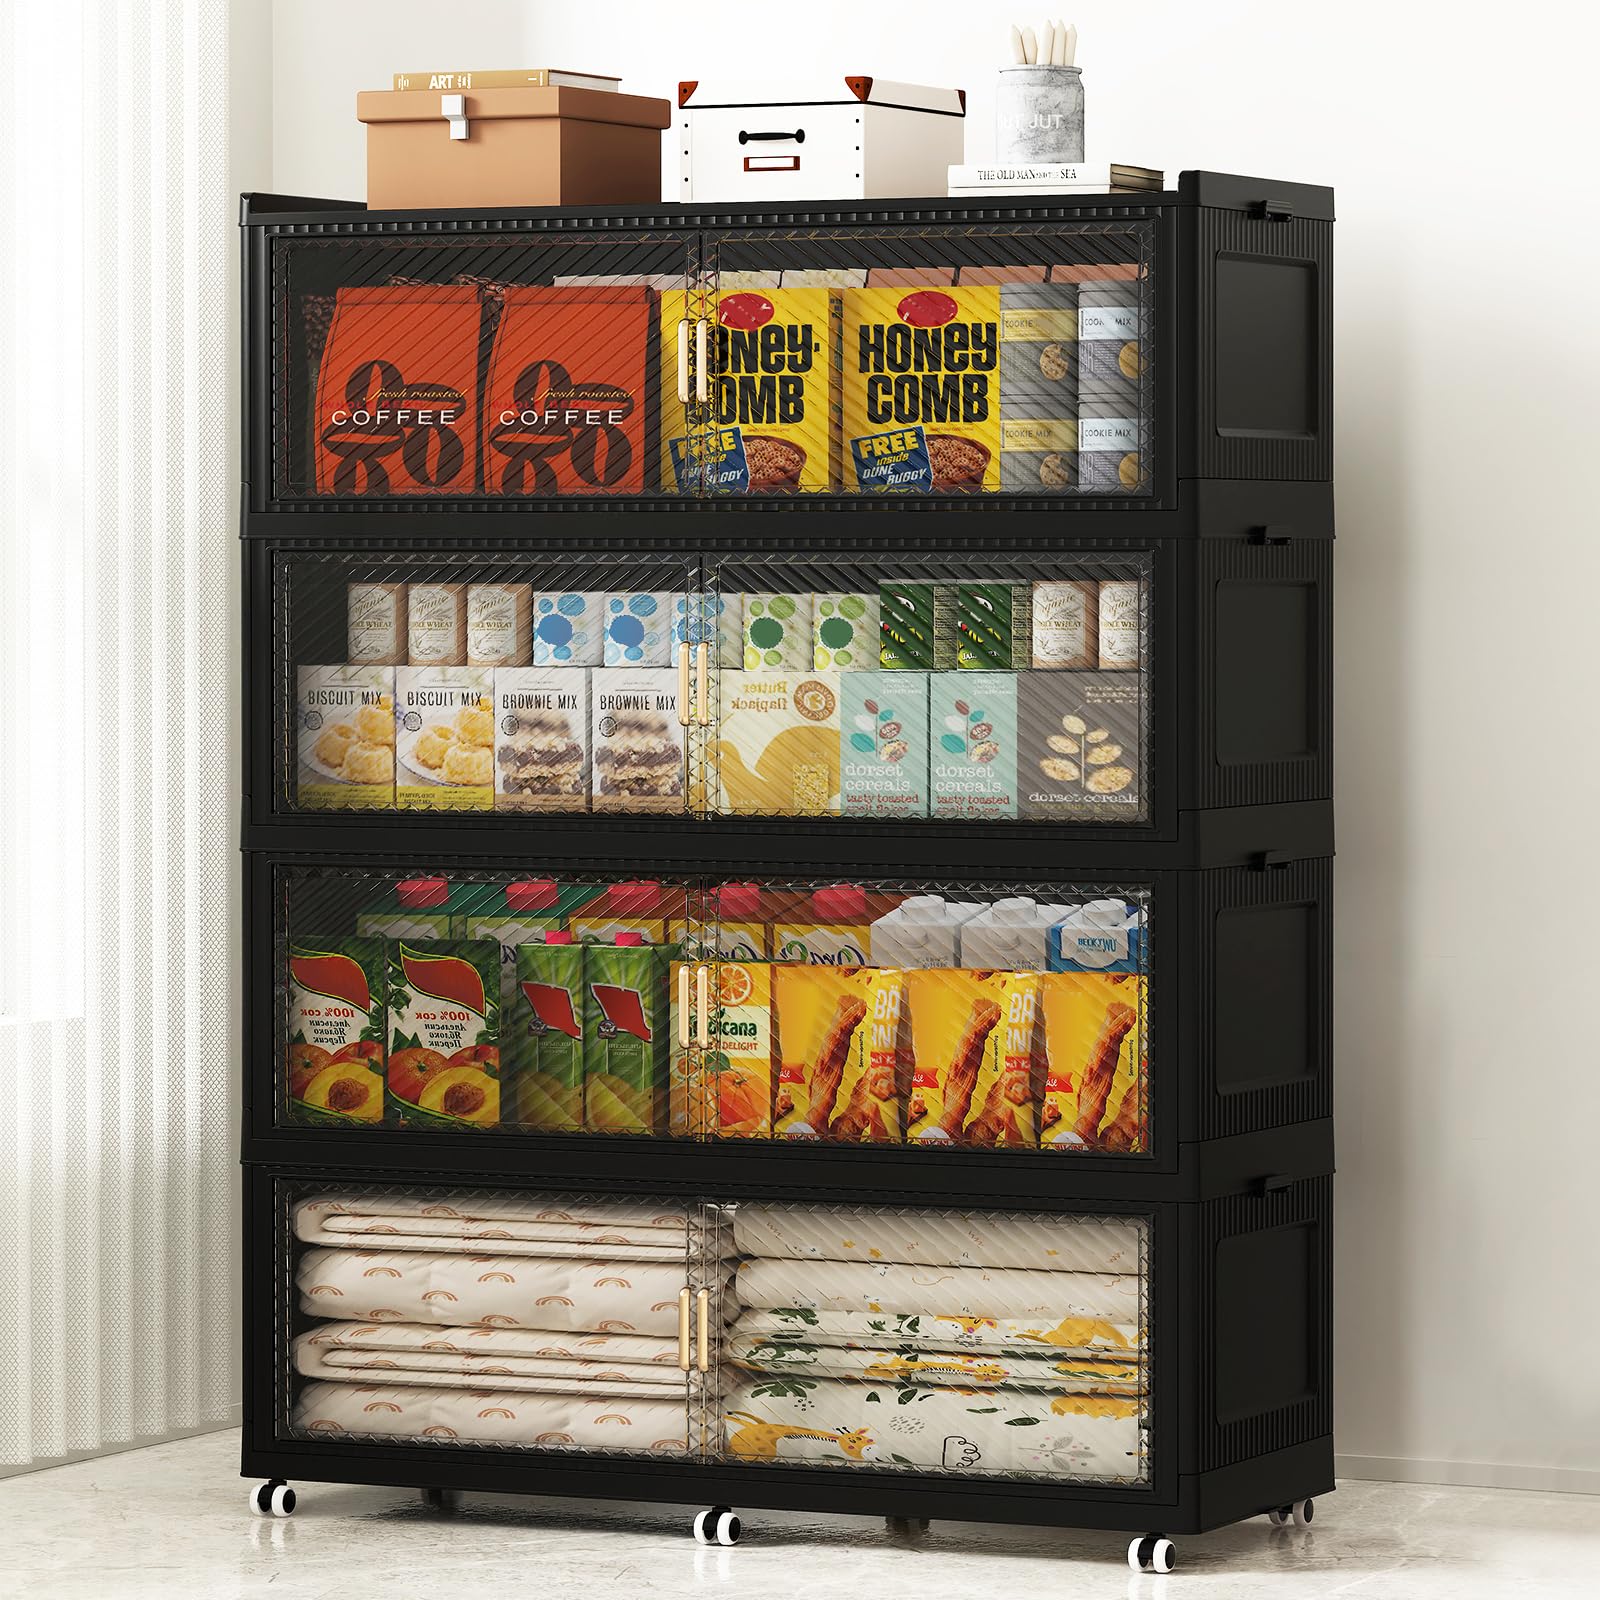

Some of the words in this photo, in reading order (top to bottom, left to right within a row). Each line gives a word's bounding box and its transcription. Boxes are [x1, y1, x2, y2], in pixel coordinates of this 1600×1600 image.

[428, 75, 454, 90] ART
[1028, 114, 1064, 129] JUT
[978, 169, 995, 180] THE
[997, 169, 1015, 180] OLD
[1017, 168, 1035, 180] MAN
[1060, 168, 1077, 179] SEA
[1005, 319, 1033, 328] COOKIE
[1115, 318, 1132, 326] MIX
[410, 388, 468, 399] roasted
[578, 388, 636, 399] roasted
[867, 373, 989, 425] COMB
[331, 410, 456, 426] COFFEE
[499, 410, 624, 426] COFFEE
[1005, 429, 1033, 438] COOKIE
[1036, 429, 1052, 438] MIX
[1085, 429, 1112, 437] COOKIE
[1115, 428, 1132, 437] MIX
[858, 430, 919, 459] FREE
[877, 452, 909, 466] inside
[863, 464, 896, 479] DUNE
[886, 468, 927, 485] BUGGY
[308, 690, 354, 706] BISCUIT
[361, 691, 382, 706] MIX
[407, 691, 454, 707] BISCUIT
[461, 691, 482, 706] MIX
[502, 694, 553, 710] BROWNIE
[558, 695, 577, 710] MIX
[600, 695, 650, 711] BROWNIE
[656, 696, 676, 711] MIX
[845, 763, 904, 777] dorset
[935, 764, 994, 778] dorset
[845, 779, 911, 792] cereals
[935, 780, 1002, 793] cereals
[846, 793, 874, 805] tasty
[877, 793, 919, 804] toasted
[937, 795, 965, 806] tasty
[968, 795, 1010, 805] toasted
[1028, 792, 1081, 803] dorset
[722, 1041, 759, 1051] DELIGHT
